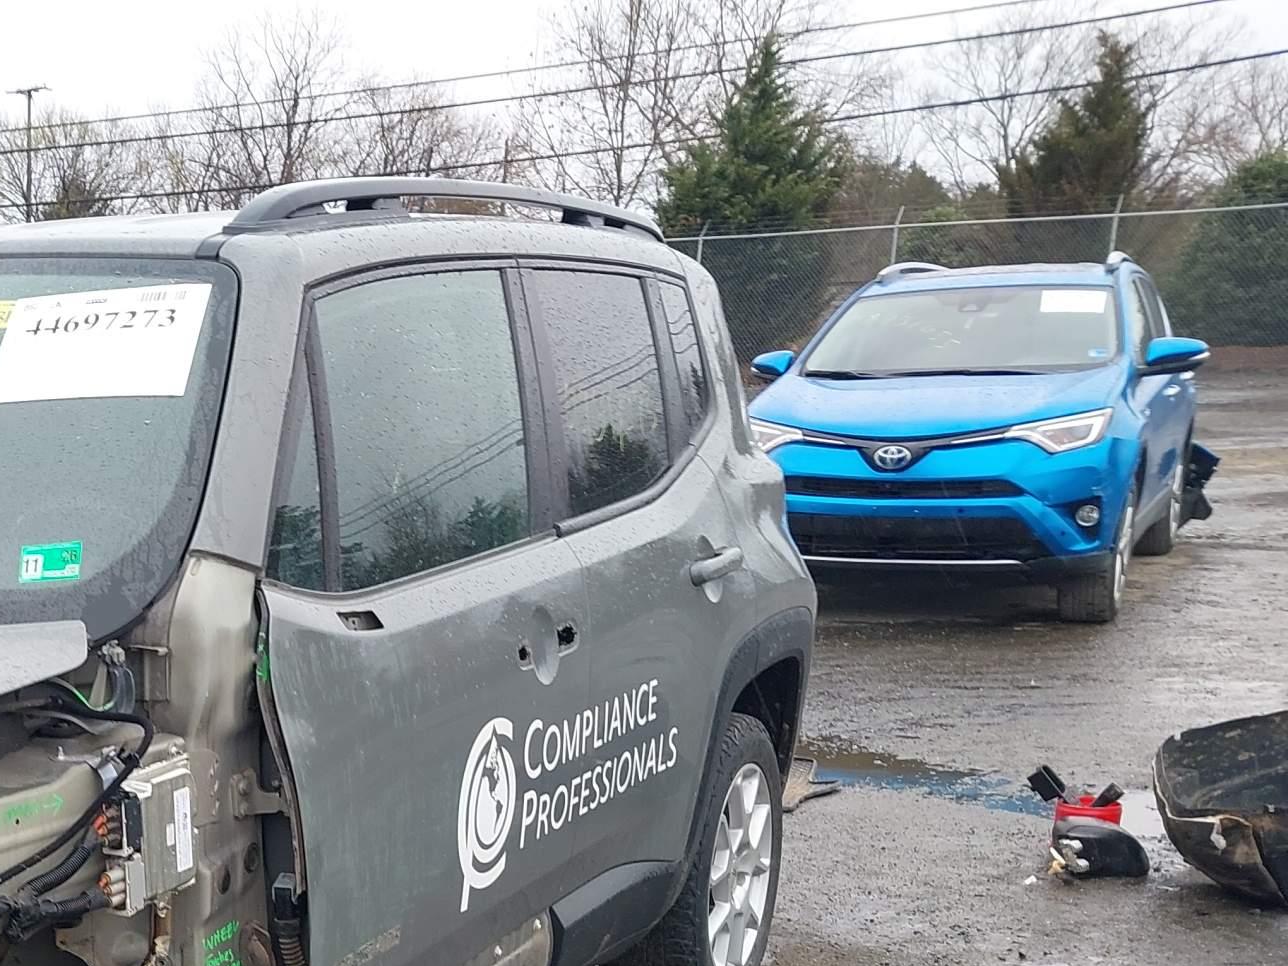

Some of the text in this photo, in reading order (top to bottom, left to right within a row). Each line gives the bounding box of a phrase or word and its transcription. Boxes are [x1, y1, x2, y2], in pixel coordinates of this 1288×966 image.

[25, 308, 178, 336] 44697273
[523, 679, 659, 779] COMPLIANCE
[519, 727, 679, 849] PROFESSIONALS
